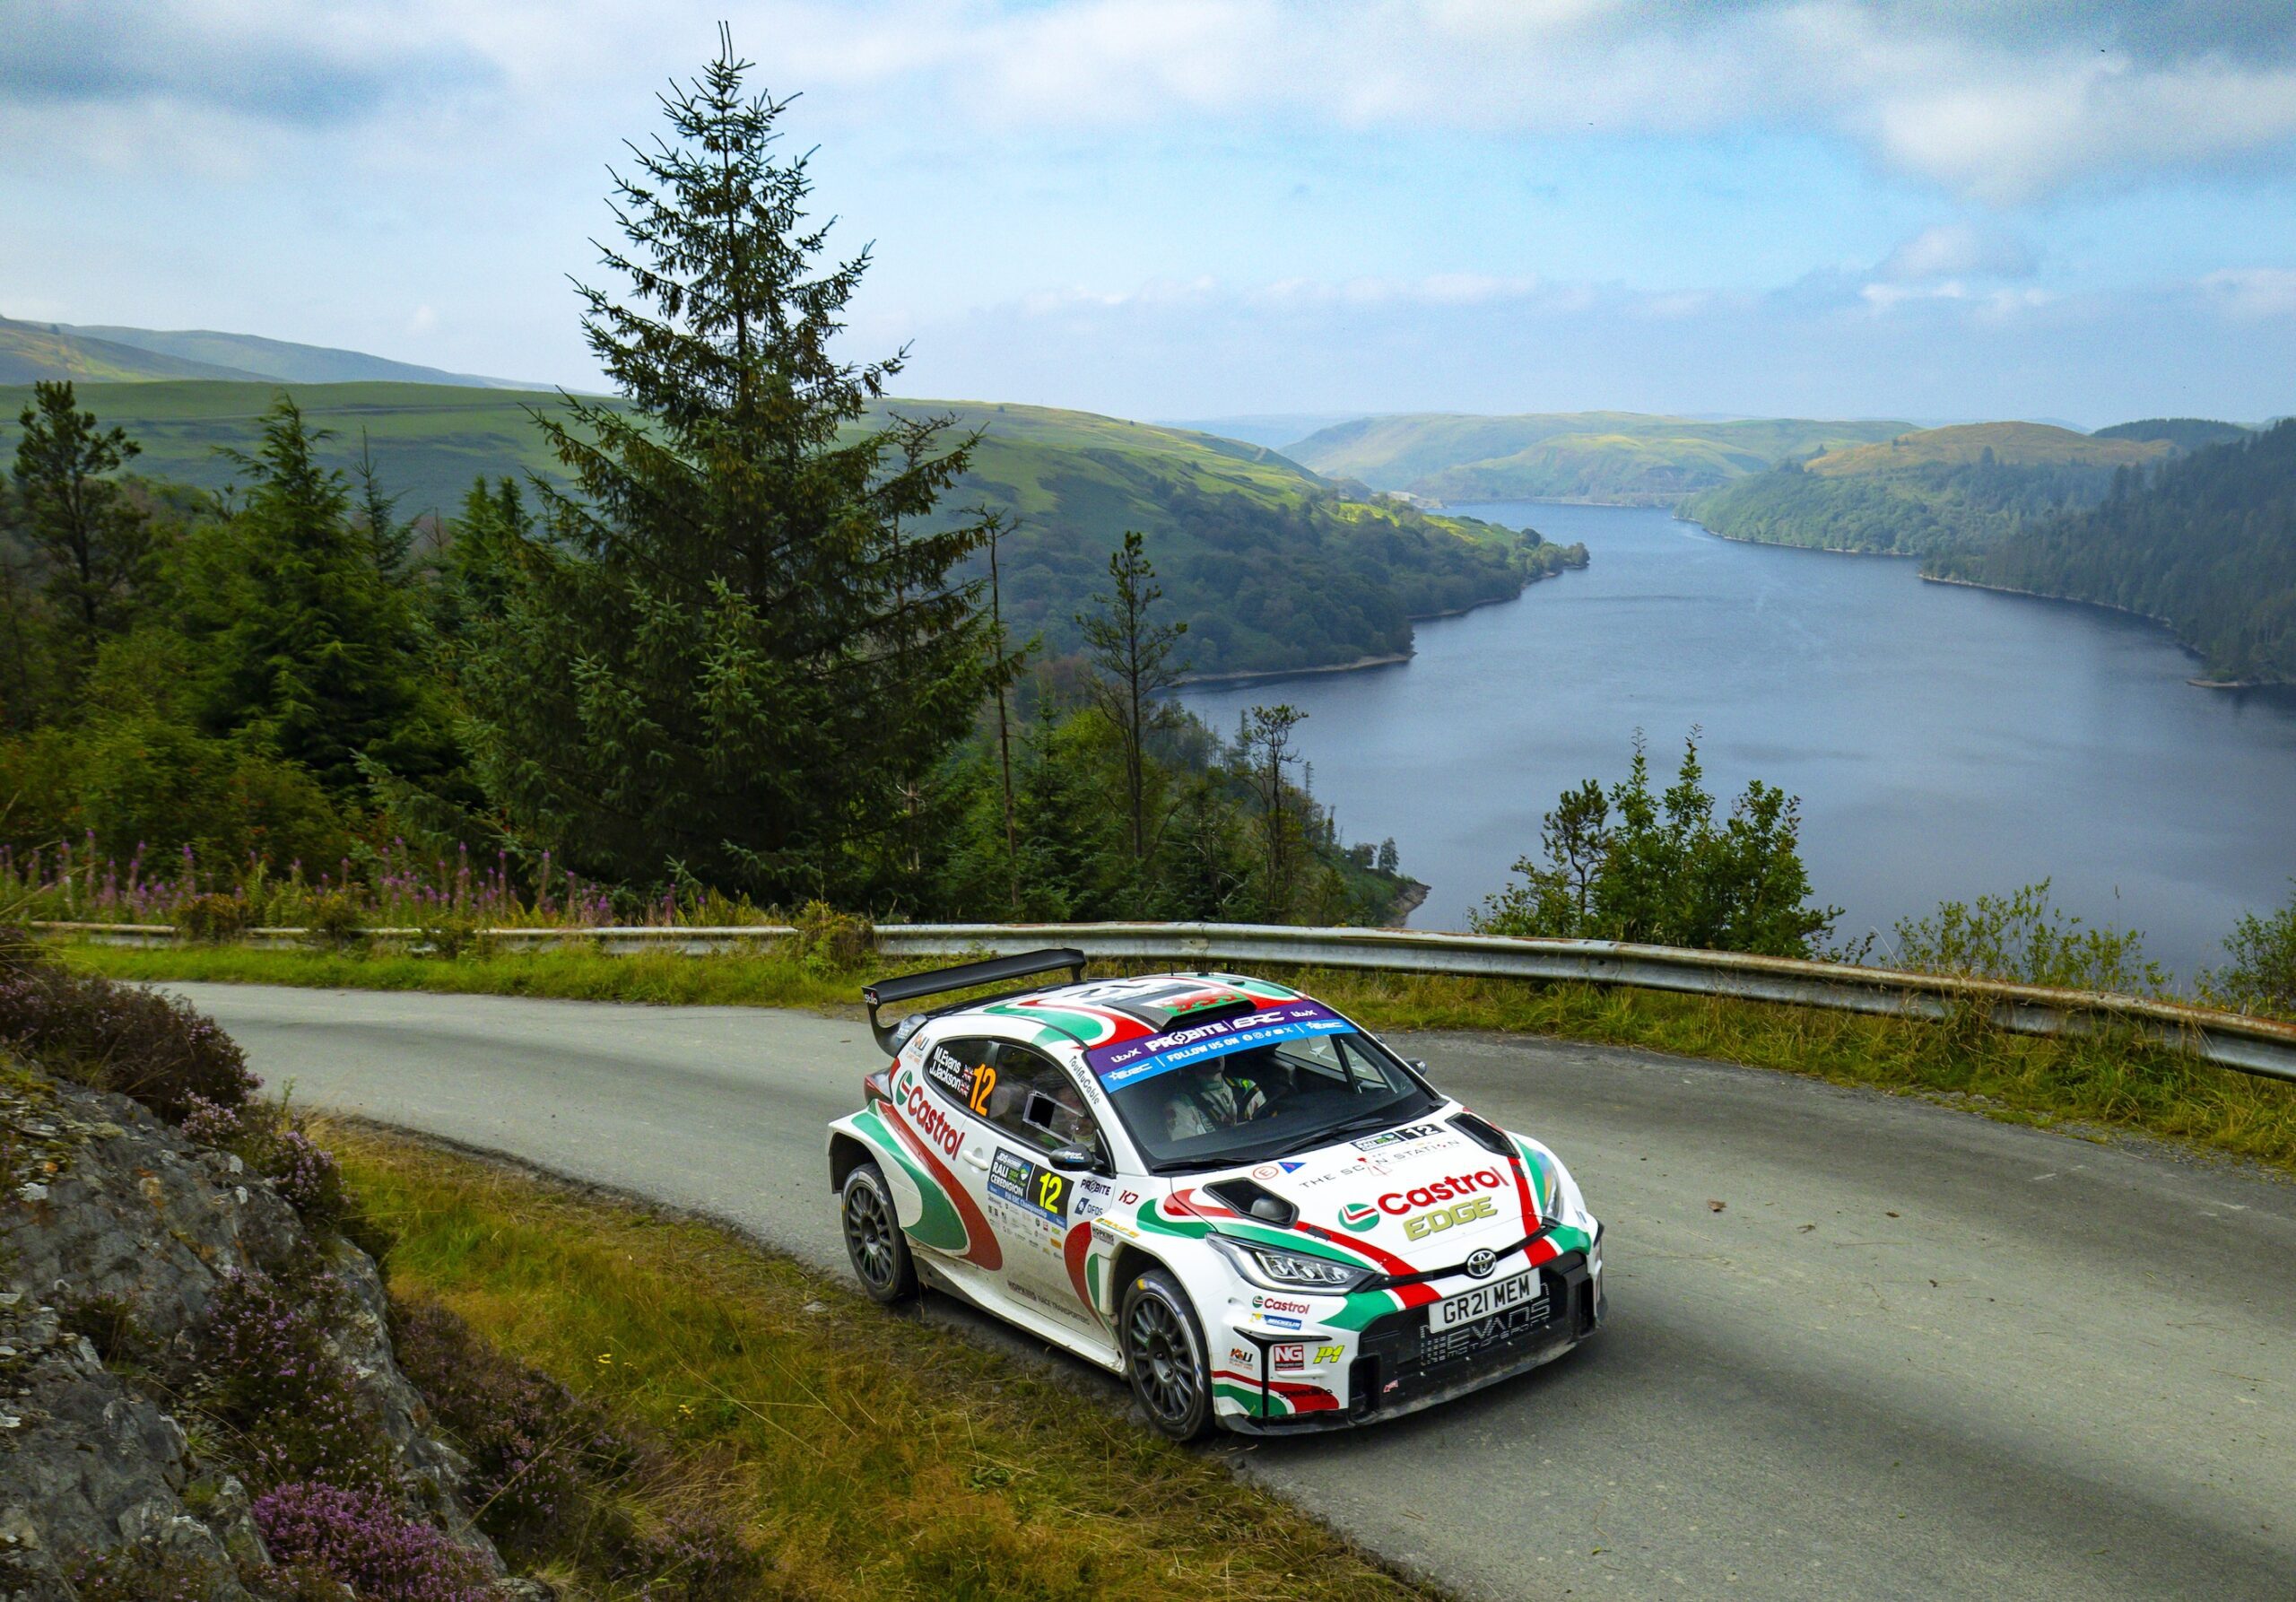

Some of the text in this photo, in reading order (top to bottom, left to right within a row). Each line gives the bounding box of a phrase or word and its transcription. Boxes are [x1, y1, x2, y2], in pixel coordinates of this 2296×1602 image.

[1232, 1011, 1284, 1029] BRC
[1144, 1022, 1229, 1051] PROBITE
[1167, 1037, 1239, 1062] FOLLOW US ON
[970, 1063, 996, 1117] 12
[908, 1085, 965, 1161] Castrol
[1405, 1125, 1439, 1137] 12
[992, 1161, 1009, 1178] RALI
[1299, 1173, 1336, 1188] THE
[990, 1173, 1023, 1197] CEREDIGION
[1039, 1171, 1063, 1214] 12
[1081, 1179, 1111, 1196] PROBITE
[1378, 1166, 1509, 1215] Castrol
[1087, 1204, 1103, 1215] DFDS
[1403, 1196, 1498, 1241] EDGE
[1264, 1298, 1310, 1315] Castrol
[1444, 1275, 1531, 1324] GR21 MEM
[1274, 1346, 1303, 1362] NG
